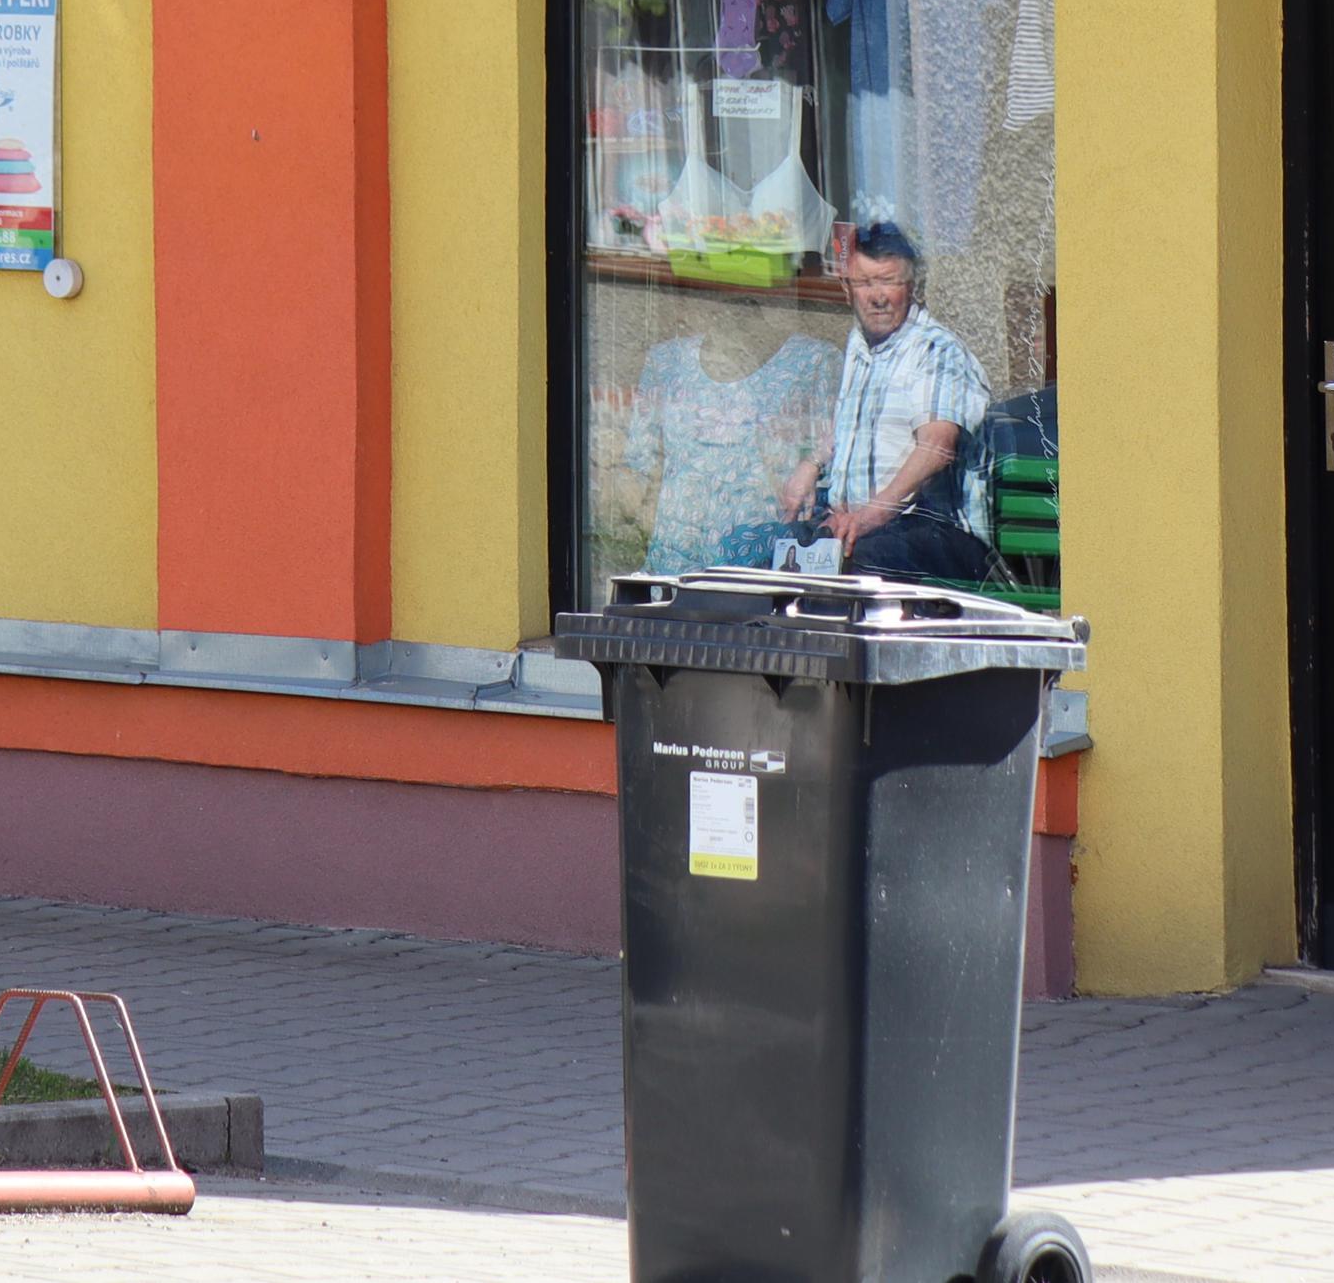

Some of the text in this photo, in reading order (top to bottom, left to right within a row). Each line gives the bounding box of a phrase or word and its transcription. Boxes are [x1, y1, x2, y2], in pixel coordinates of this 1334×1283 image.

[1020, 306, 1044, 378] simple
[1027, 387, 1059, 460] simple
[653, 741, 744, 759] Marius Pedersen
[705, 759, 744, 770] GROUP
